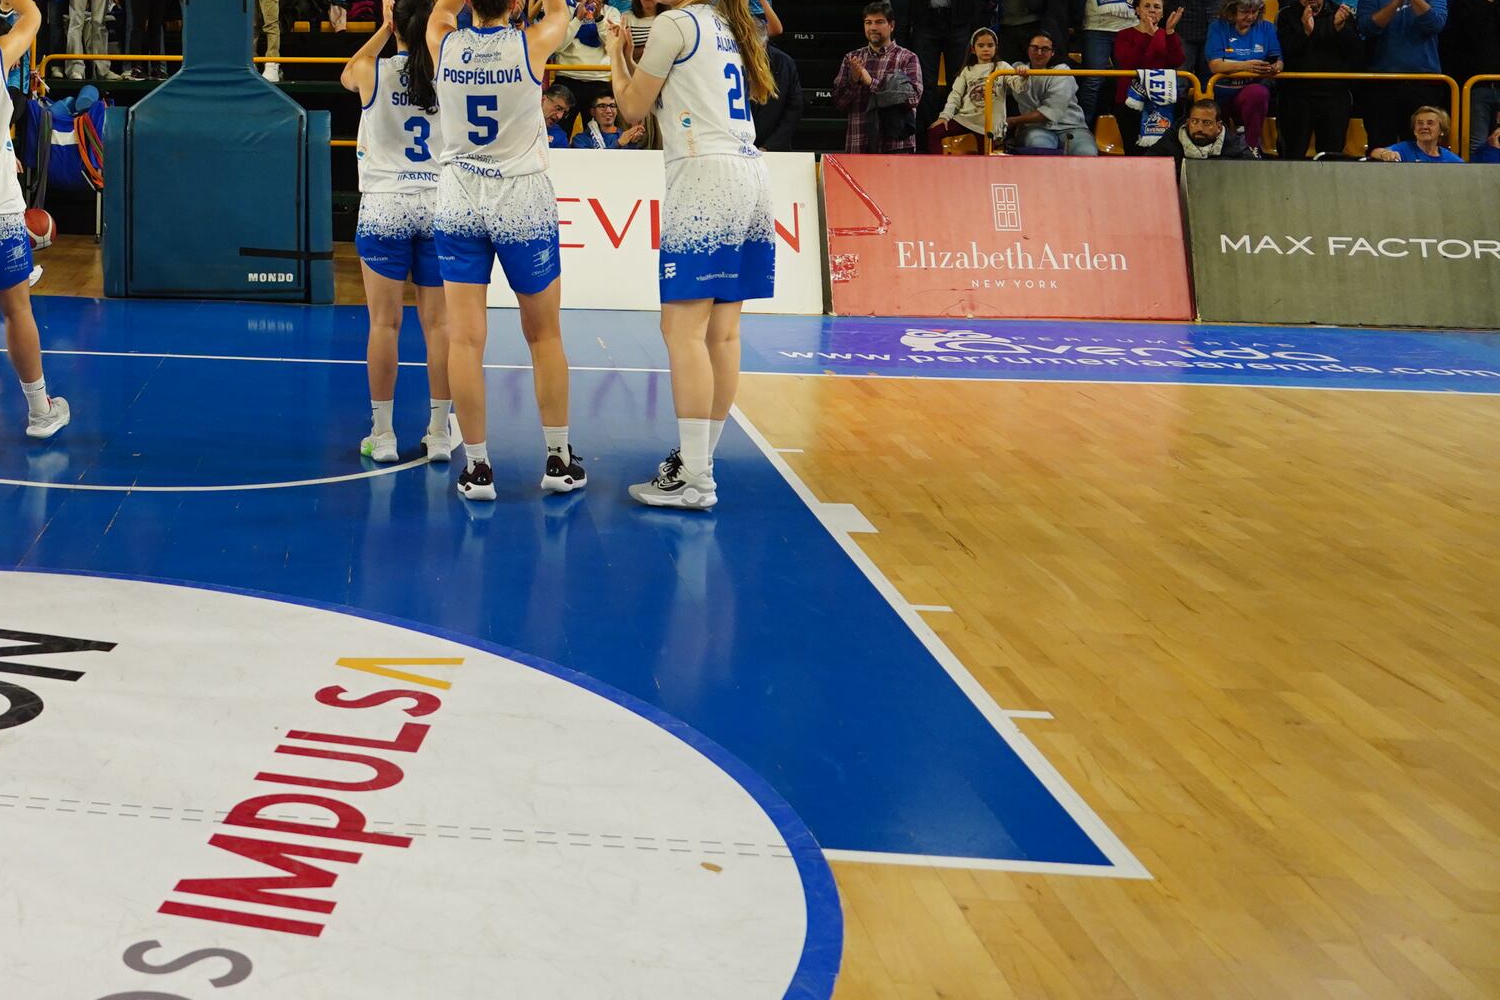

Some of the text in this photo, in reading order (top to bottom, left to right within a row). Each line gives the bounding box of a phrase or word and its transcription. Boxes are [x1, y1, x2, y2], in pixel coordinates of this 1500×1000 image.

[443, 65, 522, 85] POSPÍŠILOVÁ
[466, 95, 498, 146] 5
[404, 116, 431, 162] 3
[894, 240, 1128, 271] Elizabeth Arden
[1220, 235, 1500, 259] MAX FACTOR
[248, 273, 293, 282] MONDO
[972, 279, 1059, 289] NEW YORK
[156, 656, 466, 938] IMPULSA
